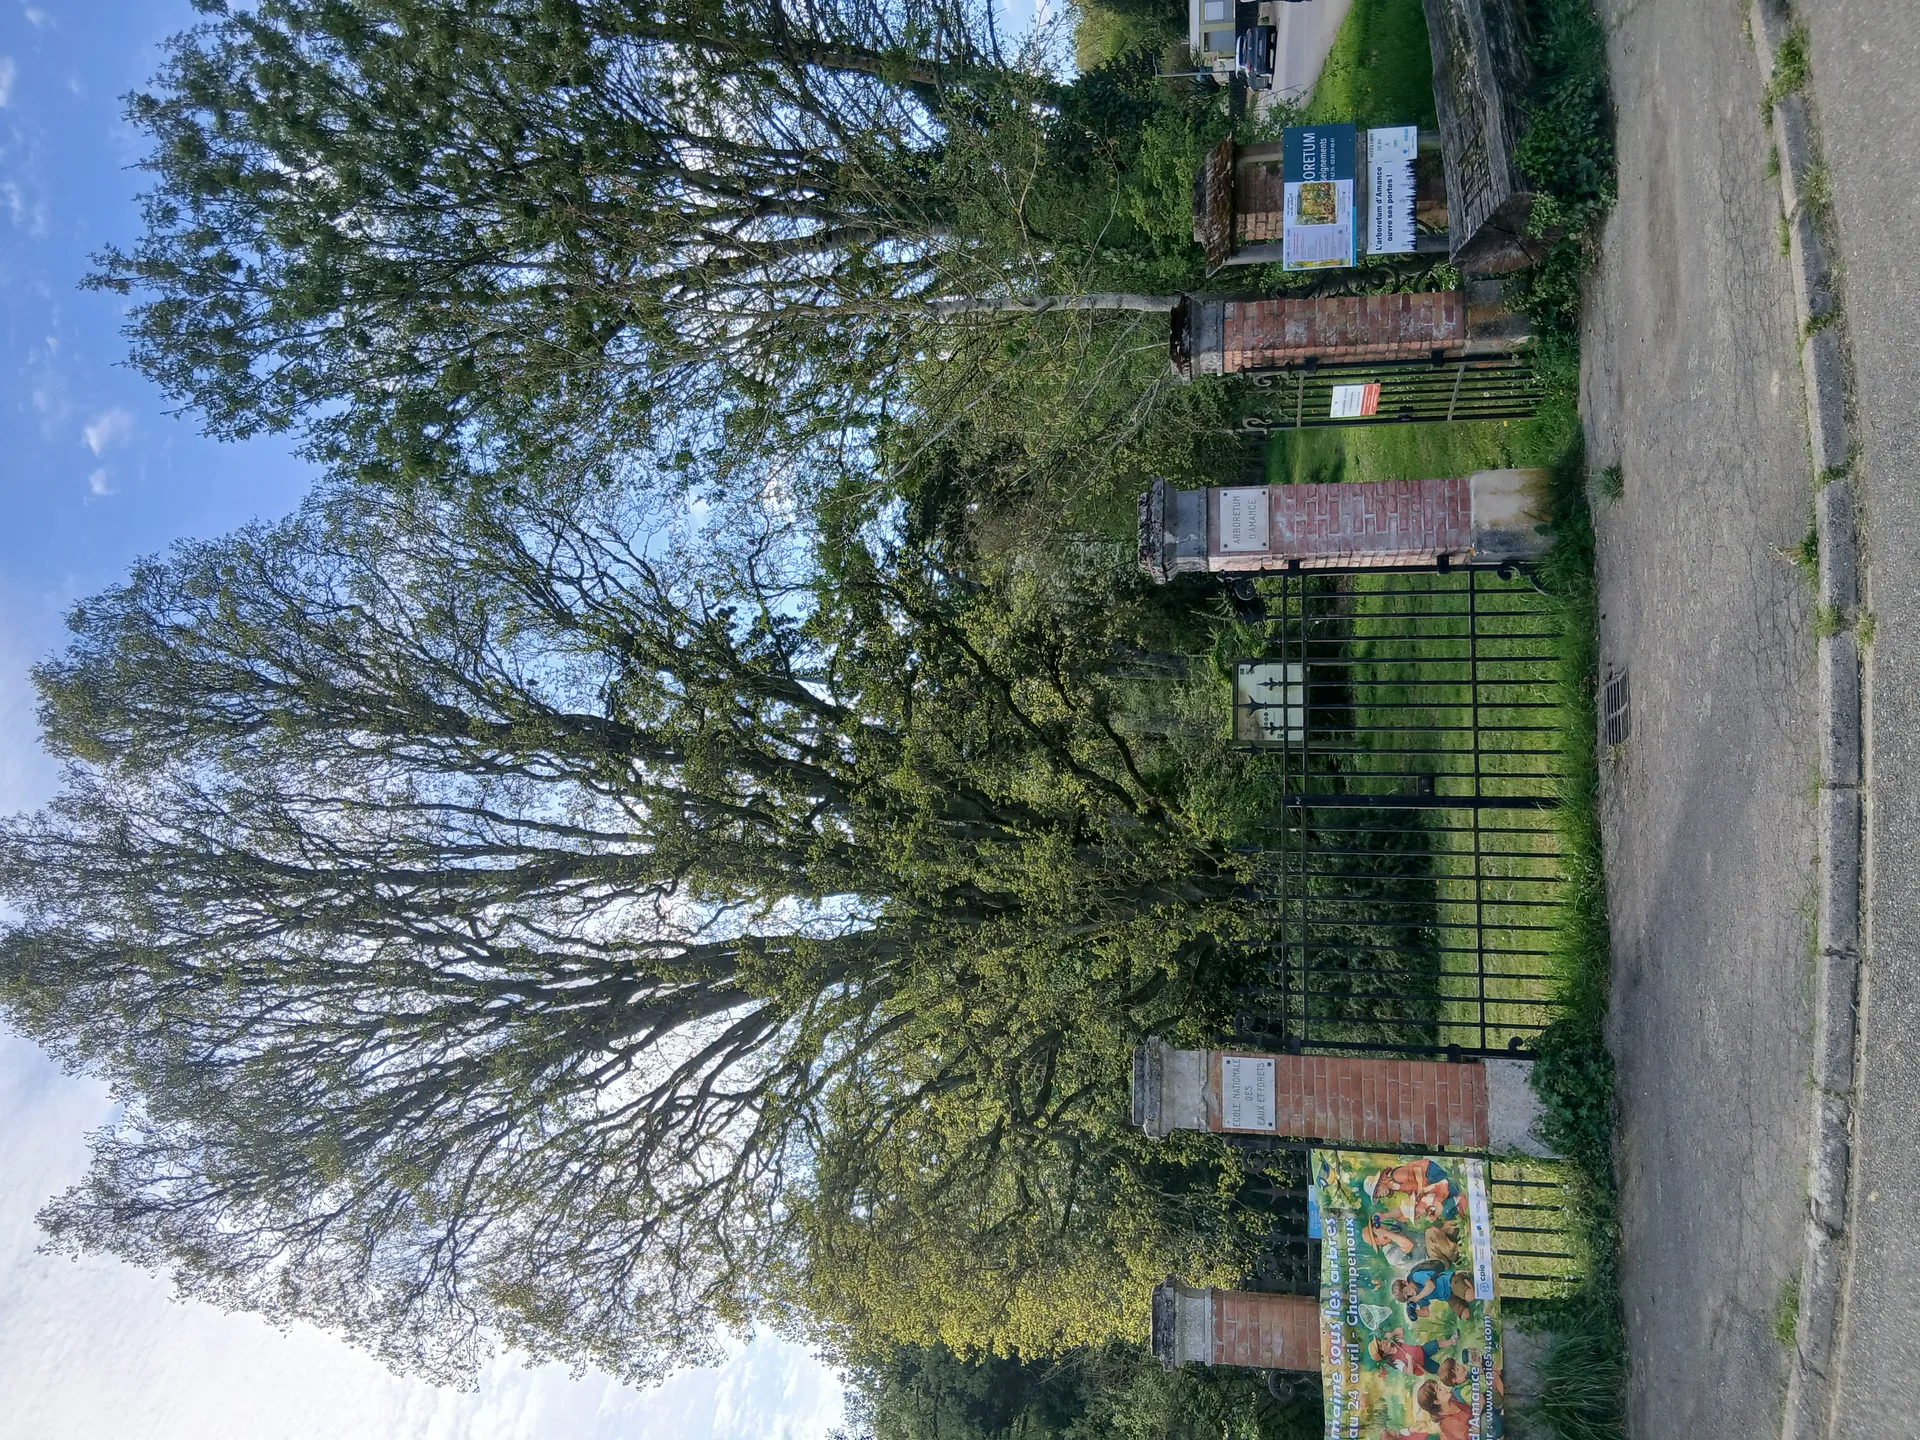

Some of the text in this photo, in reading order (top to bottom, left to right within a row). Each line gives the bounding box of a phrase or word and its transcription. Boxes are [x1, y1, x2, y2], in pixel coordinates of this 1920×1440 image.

[1232, 495, 1240, 544] ARBORETUM
[1256, 1093, 1264, 1102] ET
[1256, 1105, 1265, 1125] EAUX
[1345, 1218, 1359, 1326] Champenoux
[1478, 1264, 1486, 1282] cpie
[1324, 1218, 1342, 1439] maine sous les arbres
[1346, 1343, 1359, 1384] avril
[1483, 1315, 1494, 1422] www.cpie54.com
[1348, 1389, 1359, 1411] 24
[1468, 1367, 1480, 1440] d'Amance
[1348, 1416, 1359, 1438] au
